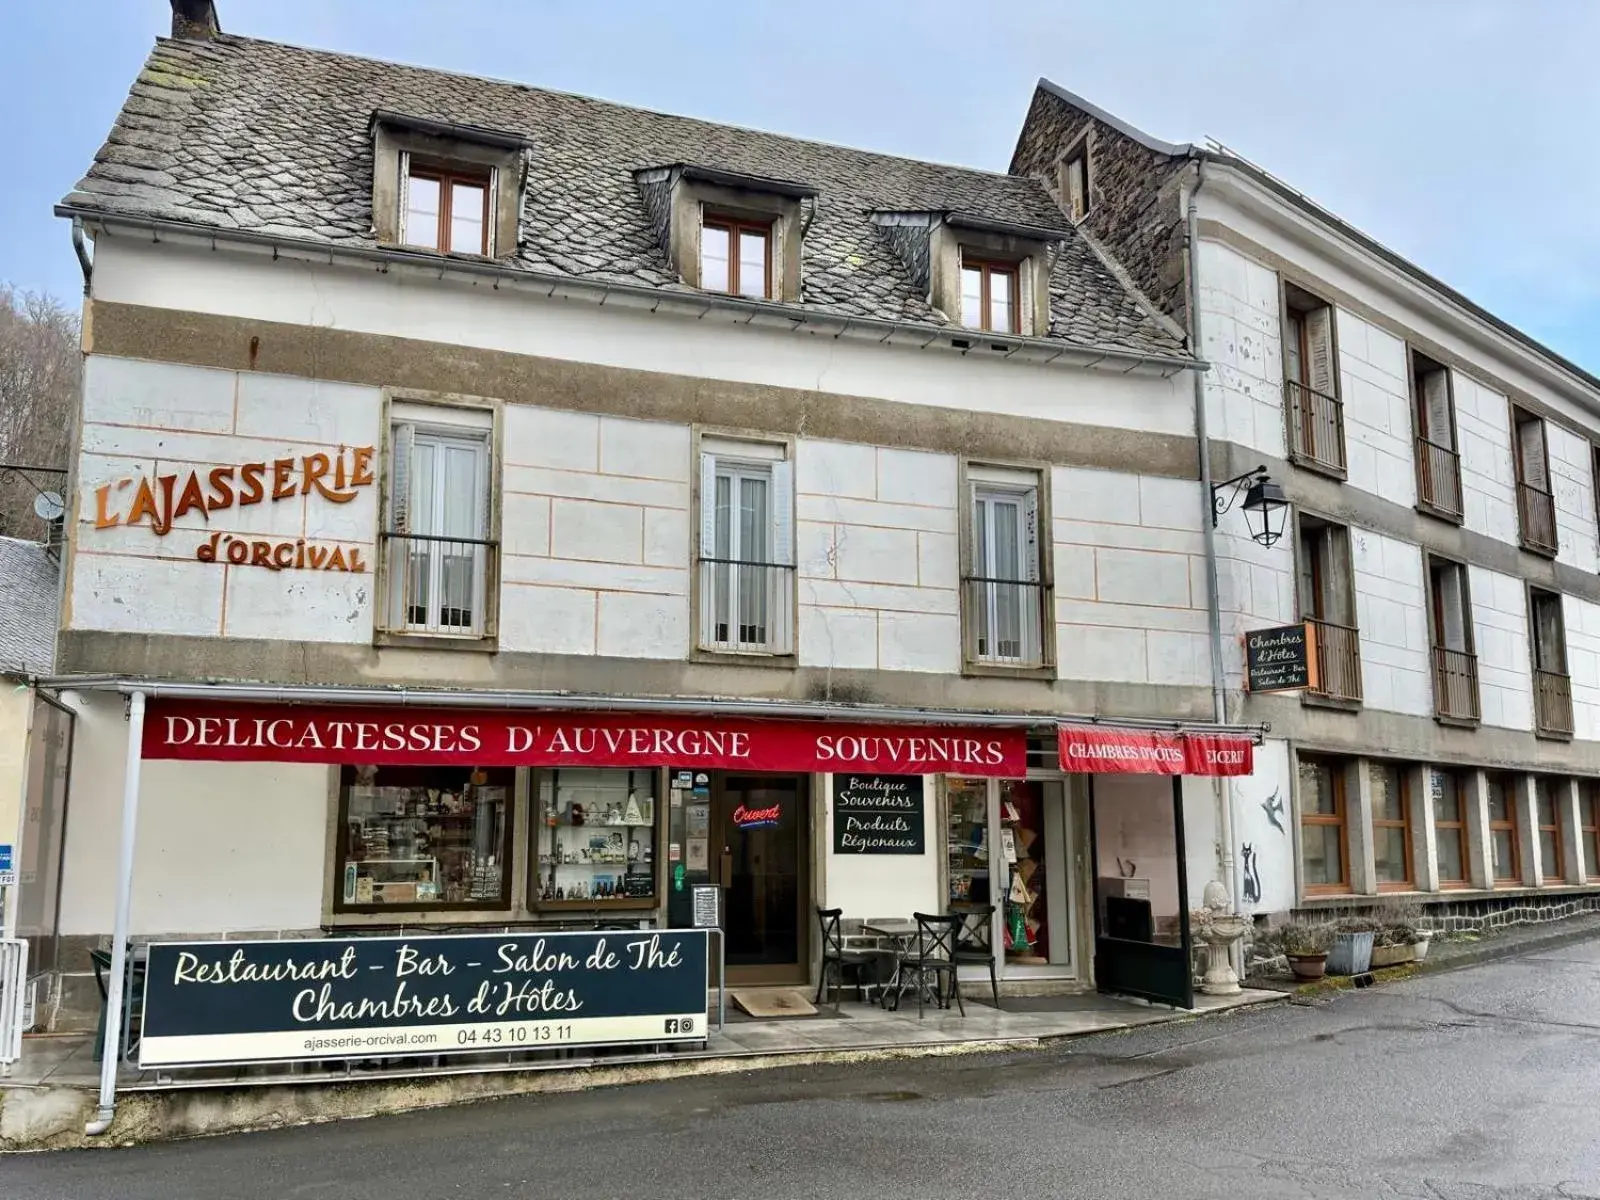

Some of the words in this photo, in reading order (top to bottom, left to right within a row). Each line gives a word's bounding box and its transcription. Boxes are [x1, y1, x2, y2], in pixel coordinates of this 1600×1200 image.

[1250, 632, 1303, 648] Chambres
[163, 715, 482, 752] DELICATESSES
[505, 726, 750, 757] D'AUVERGNE
[816, 735, 1004, 765] SOUVENIRS
[1069, 742, 1138, 760] CHAMBRES
[848, 777, 908, 797] Boutique
[838, 790, 914, 807] Souvenirs
[733, 803, 780, 823] Ouvert
[846, 816, 911, 831] Produits
[841, 833, 917, 852] Régionaux
[174, 946, 358, 986] Restaurant
[396, 944, 455, 977] Bar
[492, 938, 580, 973] Salon
[586, 938, 620, 969] de
[626, 933, 683, 970] Thé
[292, 981, 460, 1023] Chambres
[467, 979, 584, 1016] d'Hôtes
[304, 1031, 437, 1051] ajasserie-orcival.com
[457, 1029, 477, 1045] 04
[482, 1027, 502, 1044] 43
[509, 1026, 527, 1042] 10
[533, 1025, 550, 1041] 13
[558, 1025, 572, 1039] 11
